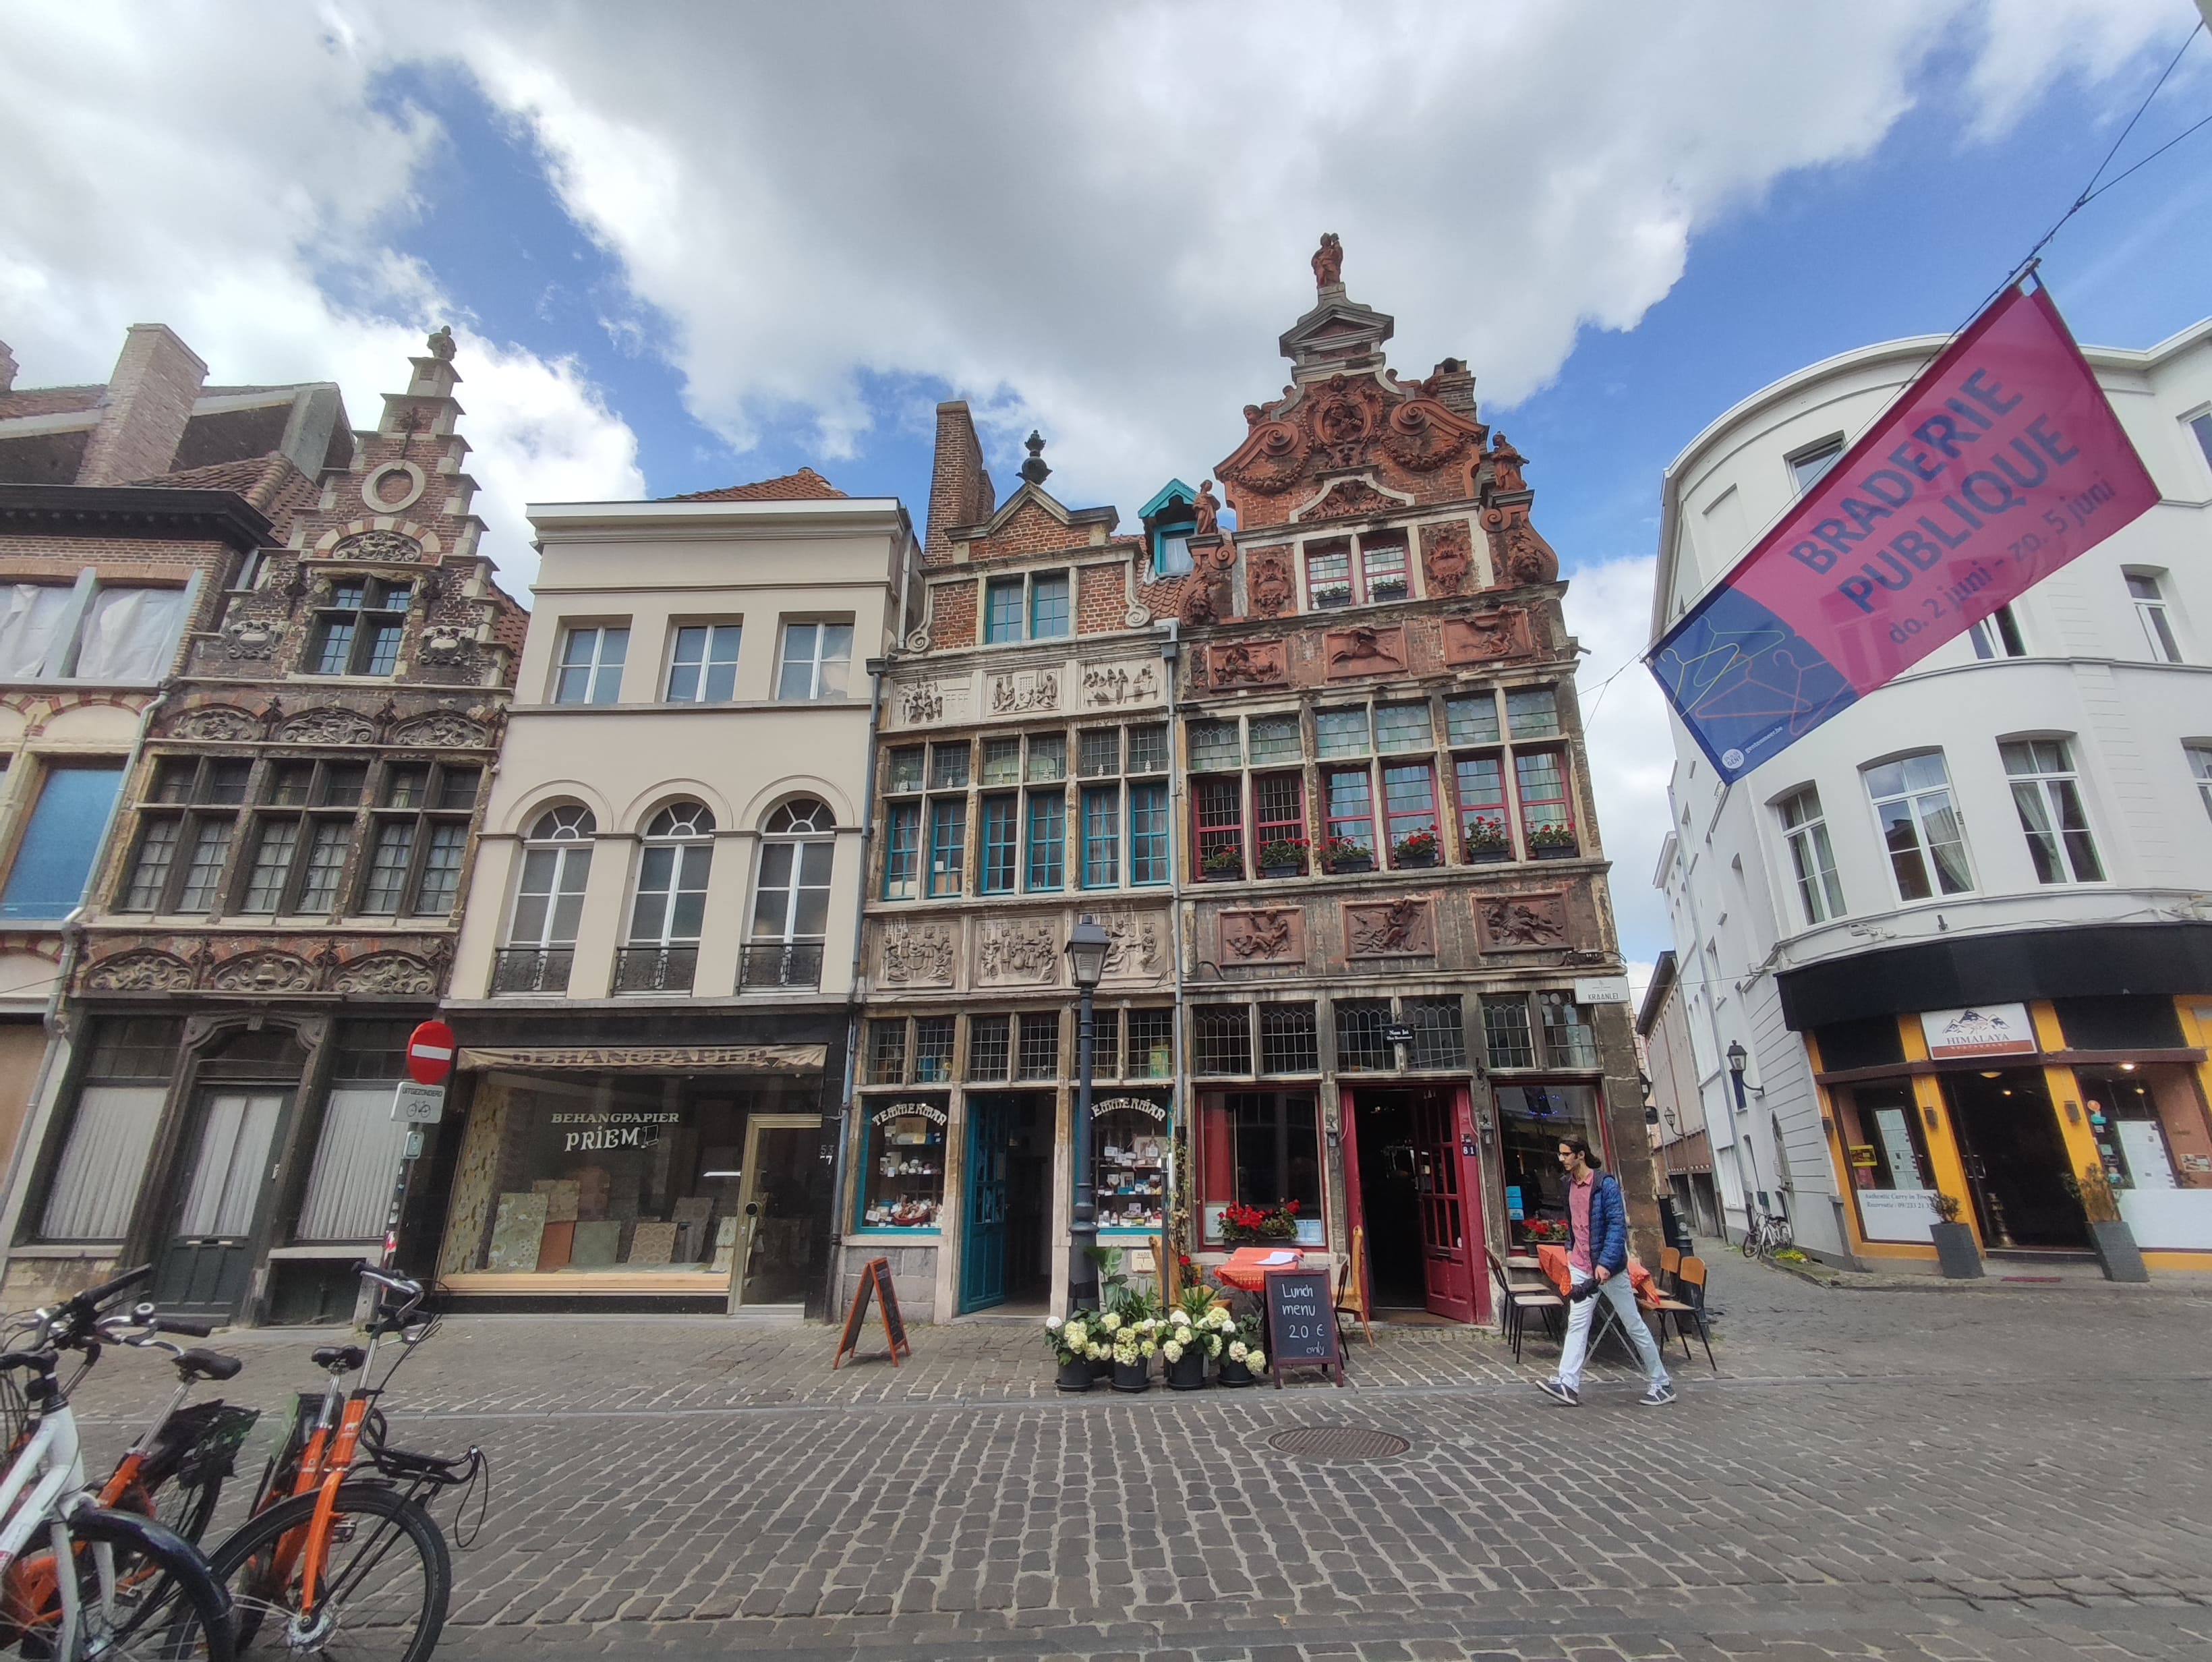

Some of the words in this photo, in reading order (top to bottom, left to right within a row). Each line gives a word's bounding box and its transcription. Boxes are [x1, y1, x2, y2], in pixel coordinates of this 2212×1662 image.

[1788, 368, 2023, 575] BRADERIE
[1838, 413, 2080, 614] PUBLIQUE
[1889, 617, 1929, 645] do.
[1923, 598, 1946, 619] 2
[1936, 560, 1993, 612] juni
[2043, 509, 2069, 534] 5
[2059, 469, 2117, 527] juni
[1588, 992, 1619, 1000] KRAANLEI
[1947, 1033, 2010, 1044] HIMALAYA
[402, 1087, 443, 1097] UITGEZONDERD
[872, 1103, 947, 1126] TEMMERMAN
[1090, 1097, 1166, 1122] EMMERMAN
[550, 1113, 679, 1124] BEHANGPAPIER
[1463, 1146, 1474, 1155] 81
[1282, 1284, 1313, 1298] Lunch
[1282, 1305, 1316, 1316] menu
[1289, 1325, 1308, 1338] 20
[1306, 1341, 1324, 1356] only
